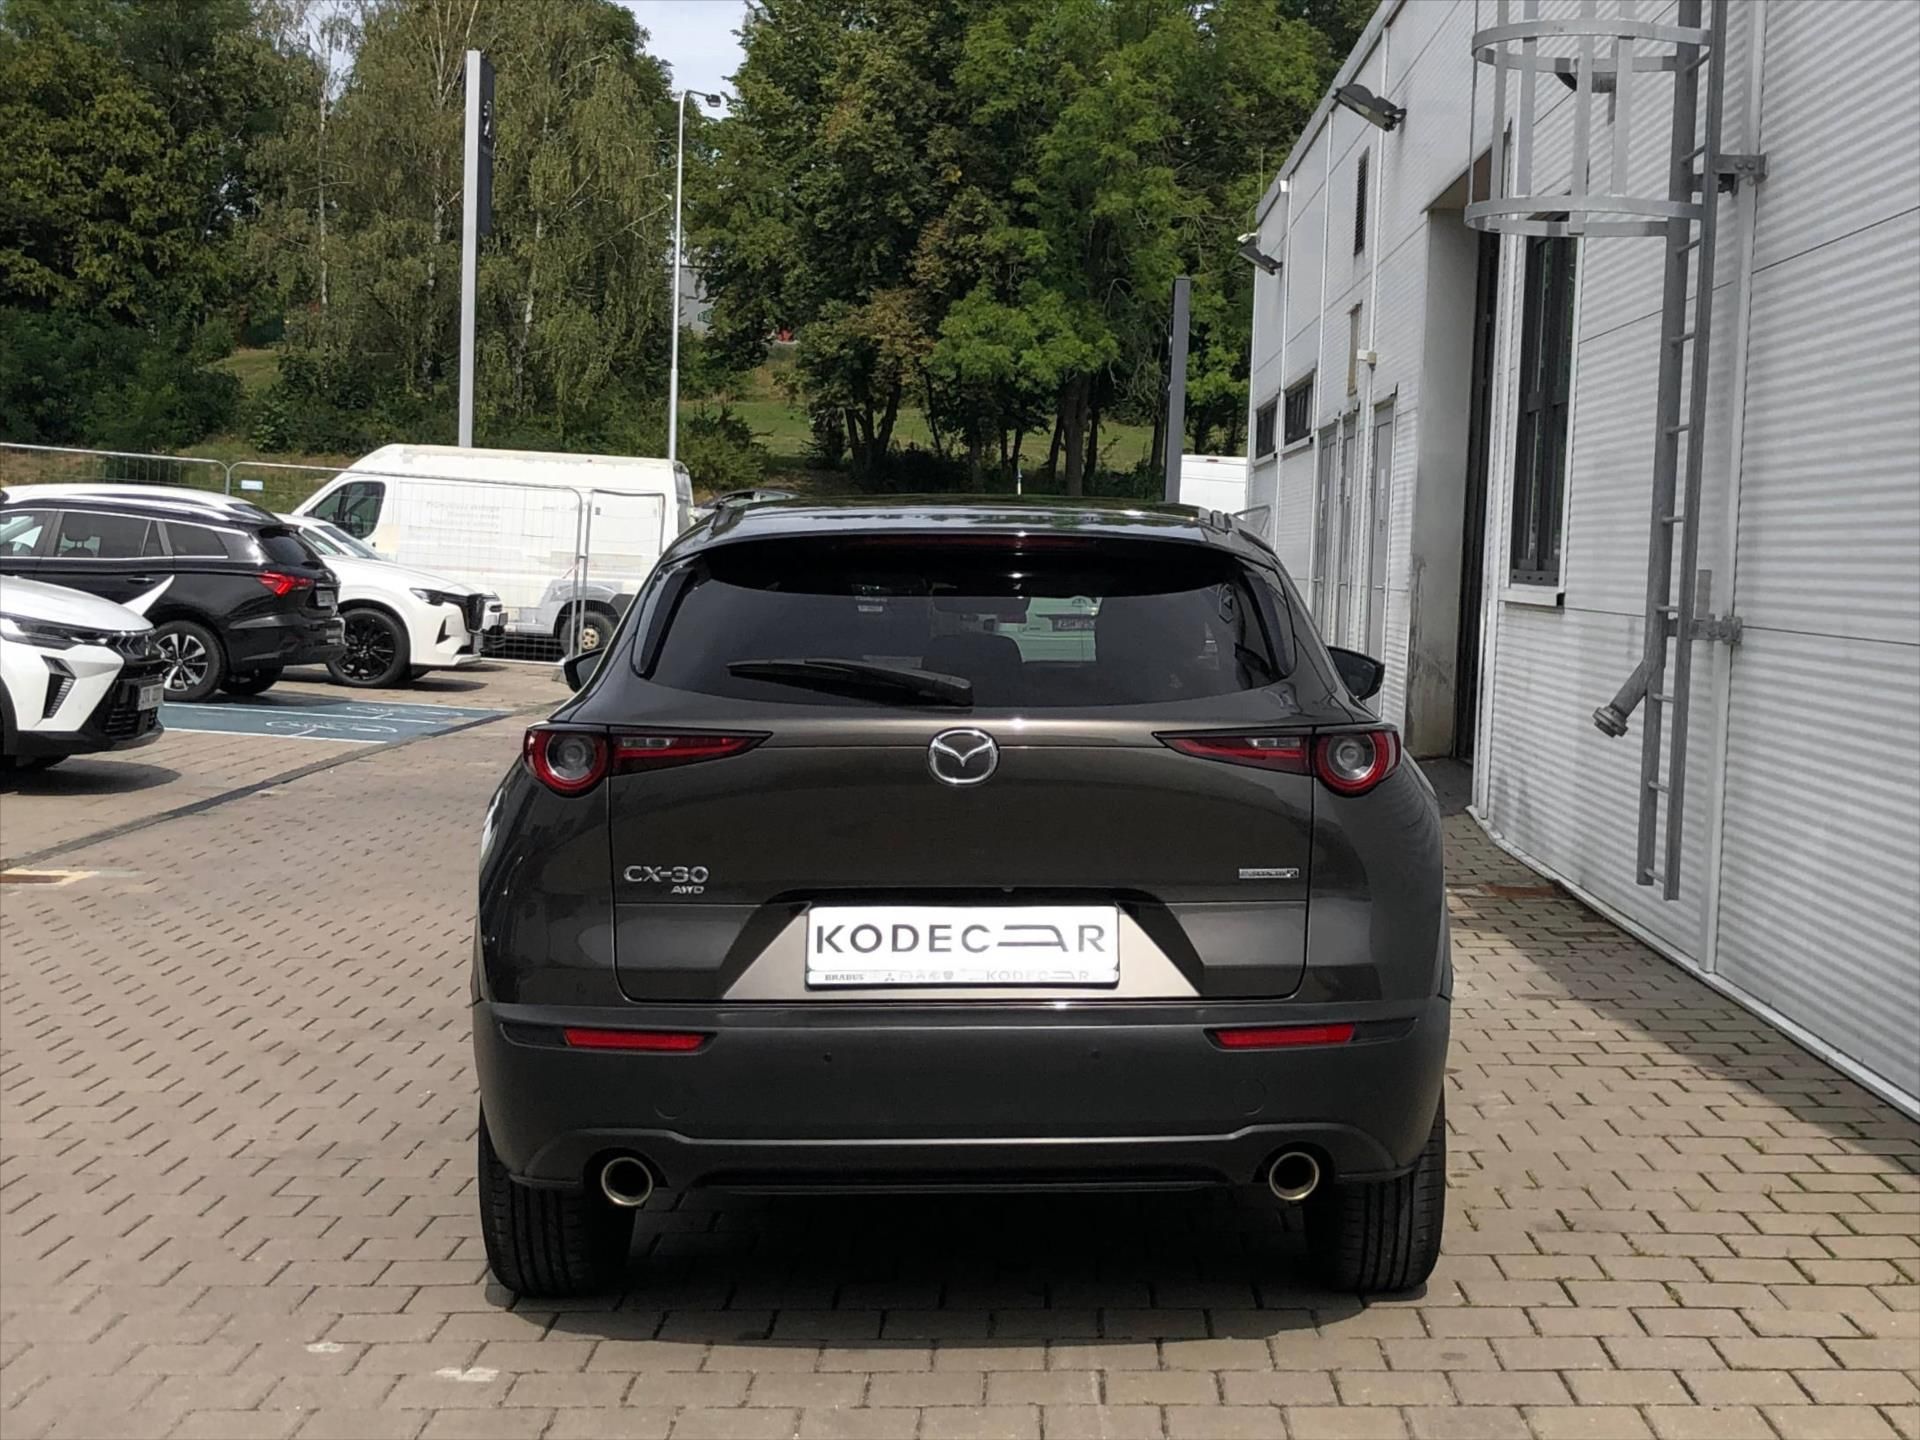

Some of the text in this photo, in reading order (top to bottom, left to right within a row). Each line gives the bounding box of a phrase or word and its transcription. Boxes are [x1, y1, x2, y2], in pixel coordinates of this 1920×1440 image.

[623, 865, 709, 883] CX-30
[671, 885, 705, 894] AWD
[816, 923, 1106, 953] KODECAR
[824, 973, 865, 981] BRABUS
